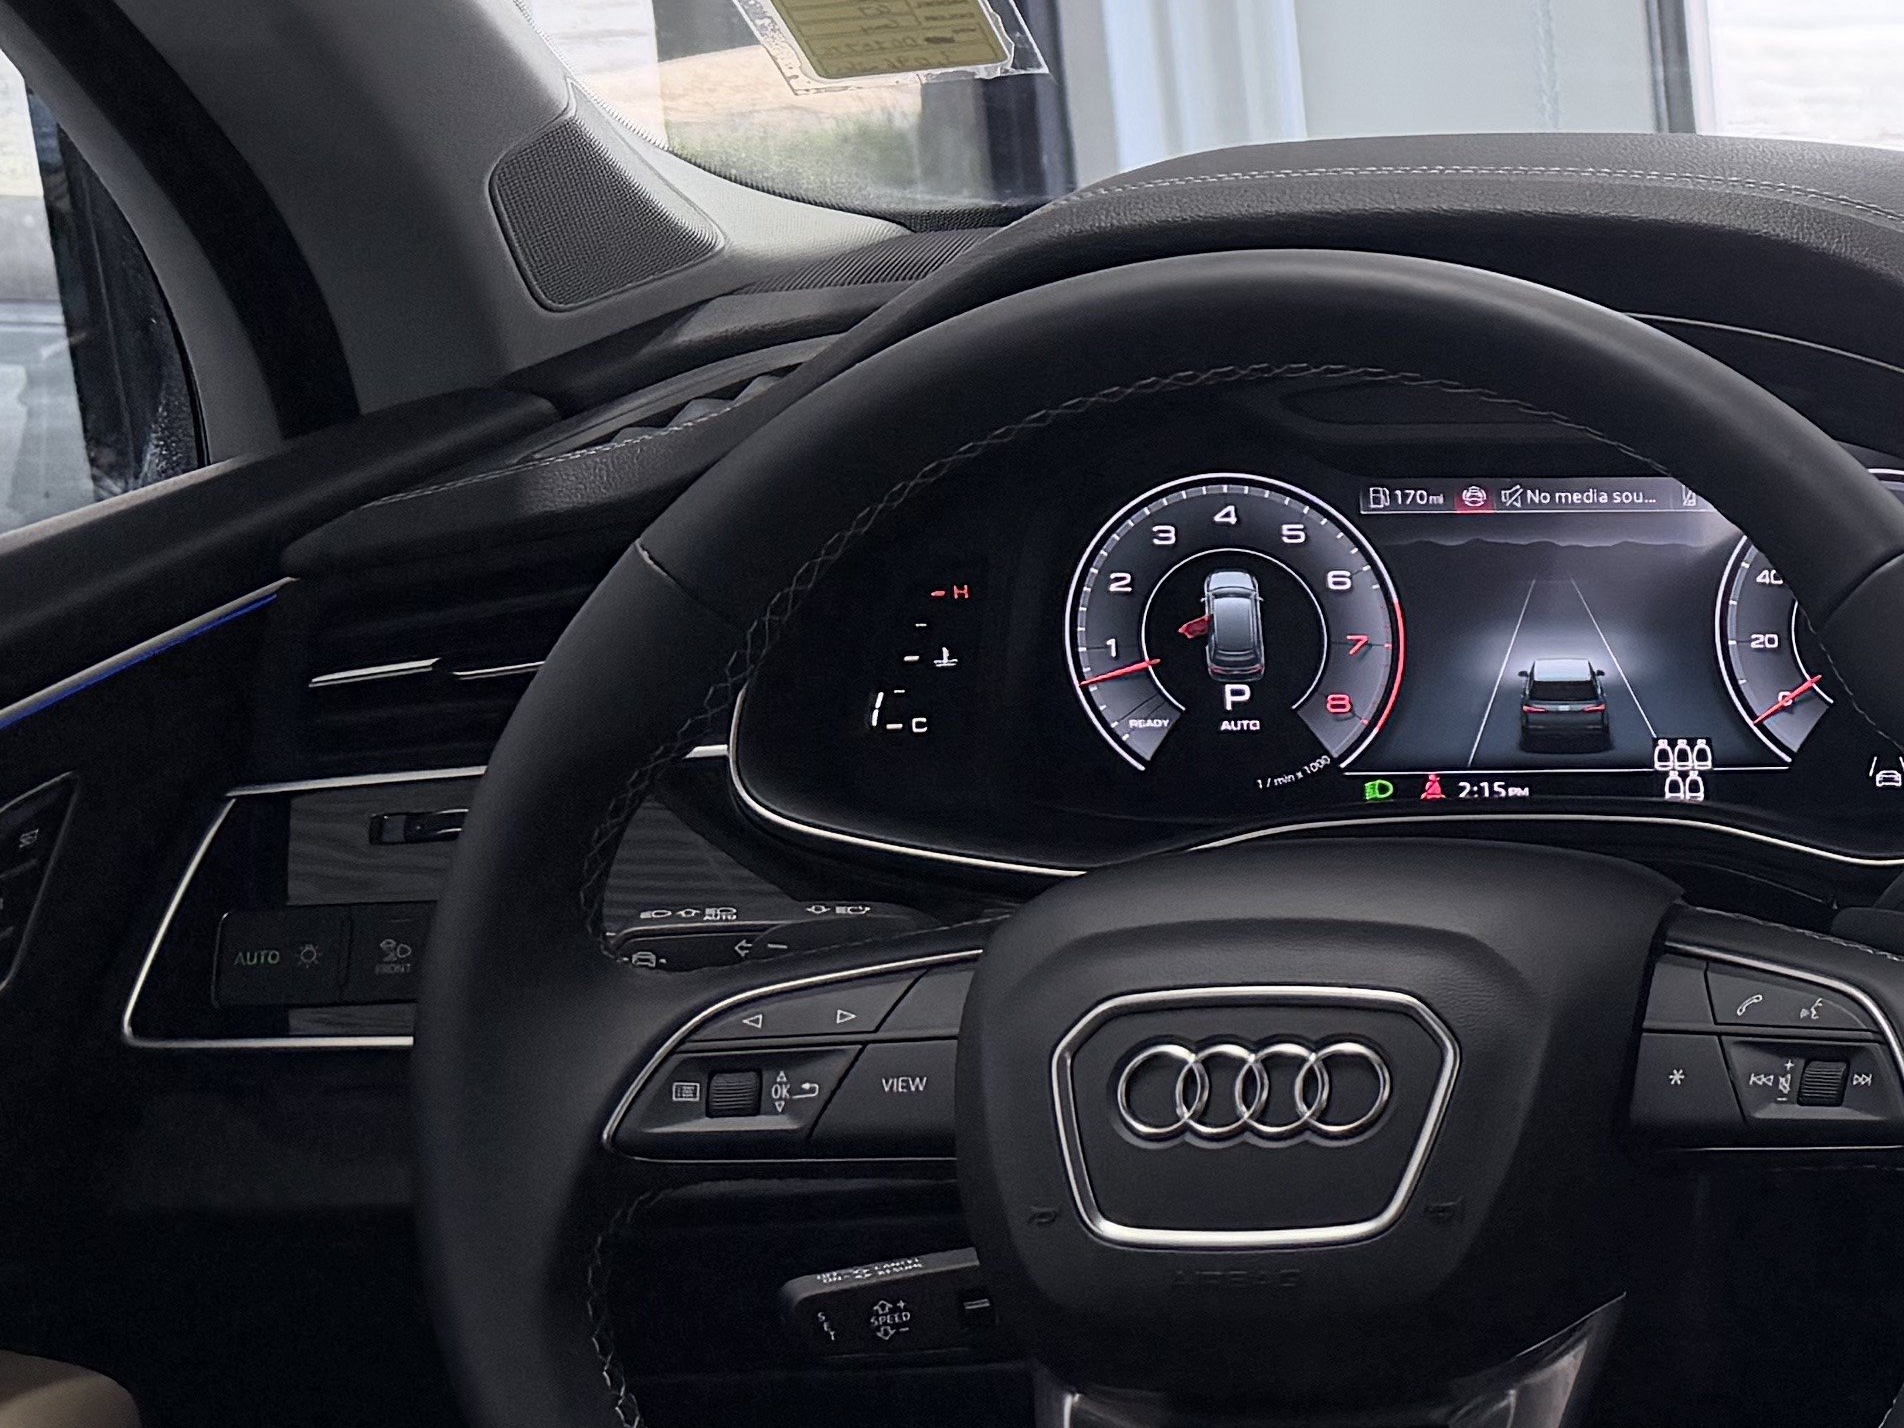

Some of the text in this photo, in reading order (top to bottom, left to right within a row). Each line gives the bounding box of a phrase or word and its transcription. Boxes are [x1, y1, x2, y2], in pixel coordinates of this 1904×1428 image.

[1526, 489, 1550, 504] No
[1555, 489, 1608, 504] media
[1214, 505, 1238, 525] 4
[1153, 525, 1176, 545] 3
[1282, 524, 1305, 543] 5
[1109, 573, 1132, 592] 2
[1327, 570, 1352, 589] 6
[954, 585, 969, 599] H
[1106, 638, 1118, 657] 1
[1347, 635, 1369, 655] 7
[1751, 634, 1778, 649] 20
[1224, 683, 1251, 710] P
[1327, 694, 1351, 713] 8
[911, 718, 928, 733] C
[1128, 718, 1170, 730] READY
[1220, 719, 1260, 731] AUTO
[233, 949, 280, 966] AUTO
[771, 1083, 791, 1100] OK
[881, 1077, 927, 1093] VIEW
[870, 1310, 911, 1327] SPEED
